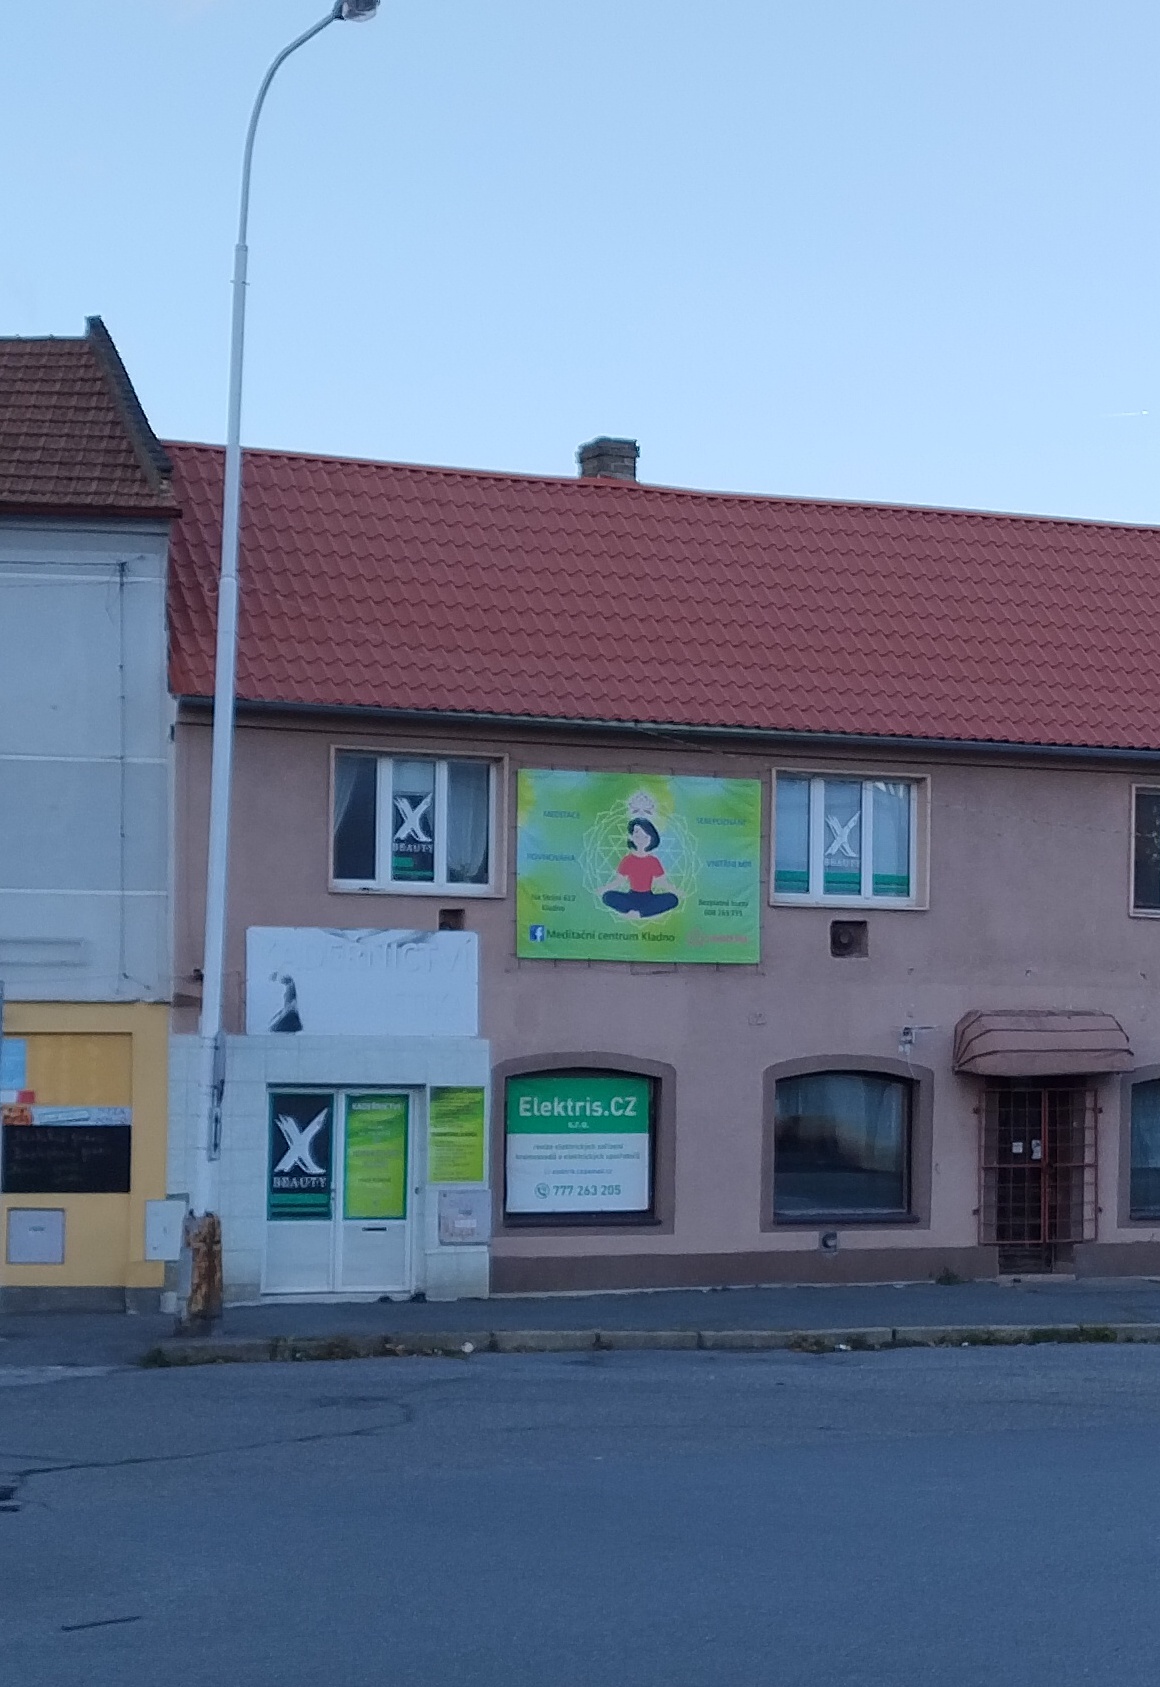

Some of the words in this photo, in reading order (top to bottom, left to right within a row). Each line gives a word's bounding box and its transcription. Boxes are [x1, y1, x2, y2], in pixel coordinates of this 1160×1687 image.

[546, 928, 596, 941] Meditační
[598, 931, 639, 942] centrum
[641, 931, 676, 943] Kladno
[519, 1097, 637, 1117] Elektris.CZ
[272, 1176, 328, 1189] BEAUTY
[553, 1185, 574, 1196] 777
[577, 1185, 598, 1196] 263
[601, 1185, 622, 1196] 205
